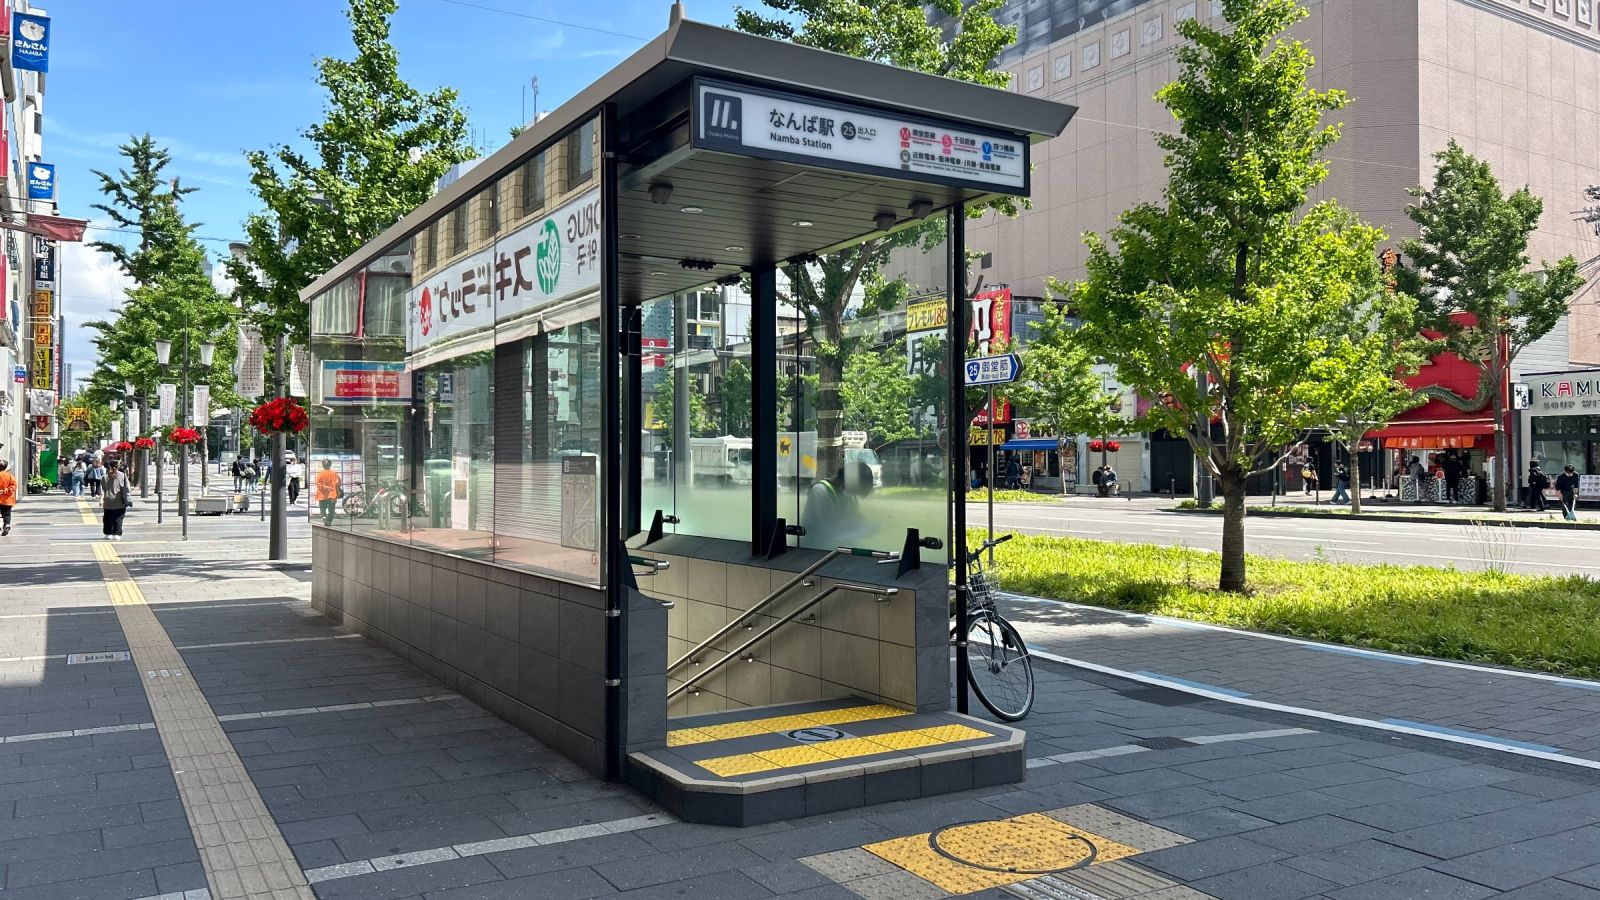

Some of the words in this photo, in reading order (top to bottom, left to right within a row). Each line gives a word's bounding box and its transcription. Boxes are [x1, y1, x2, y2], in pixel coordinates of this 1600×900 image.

[18, 48, 43, 57] NAMBA
[769, 108, 835, 138] なんば駅
[842, 125, 855, 137] 25
[857, 126, 877, 137] 出入口
[769, 133, 800, 145] Namba
[802, 136, 832, 150] Station
[969, 365, 978, 377] 25
[981, 359, 1009, 373] 御堂筋
[1543, 400, 1575, 410] SOUP
[1582, 399, 1600, 408] WI
